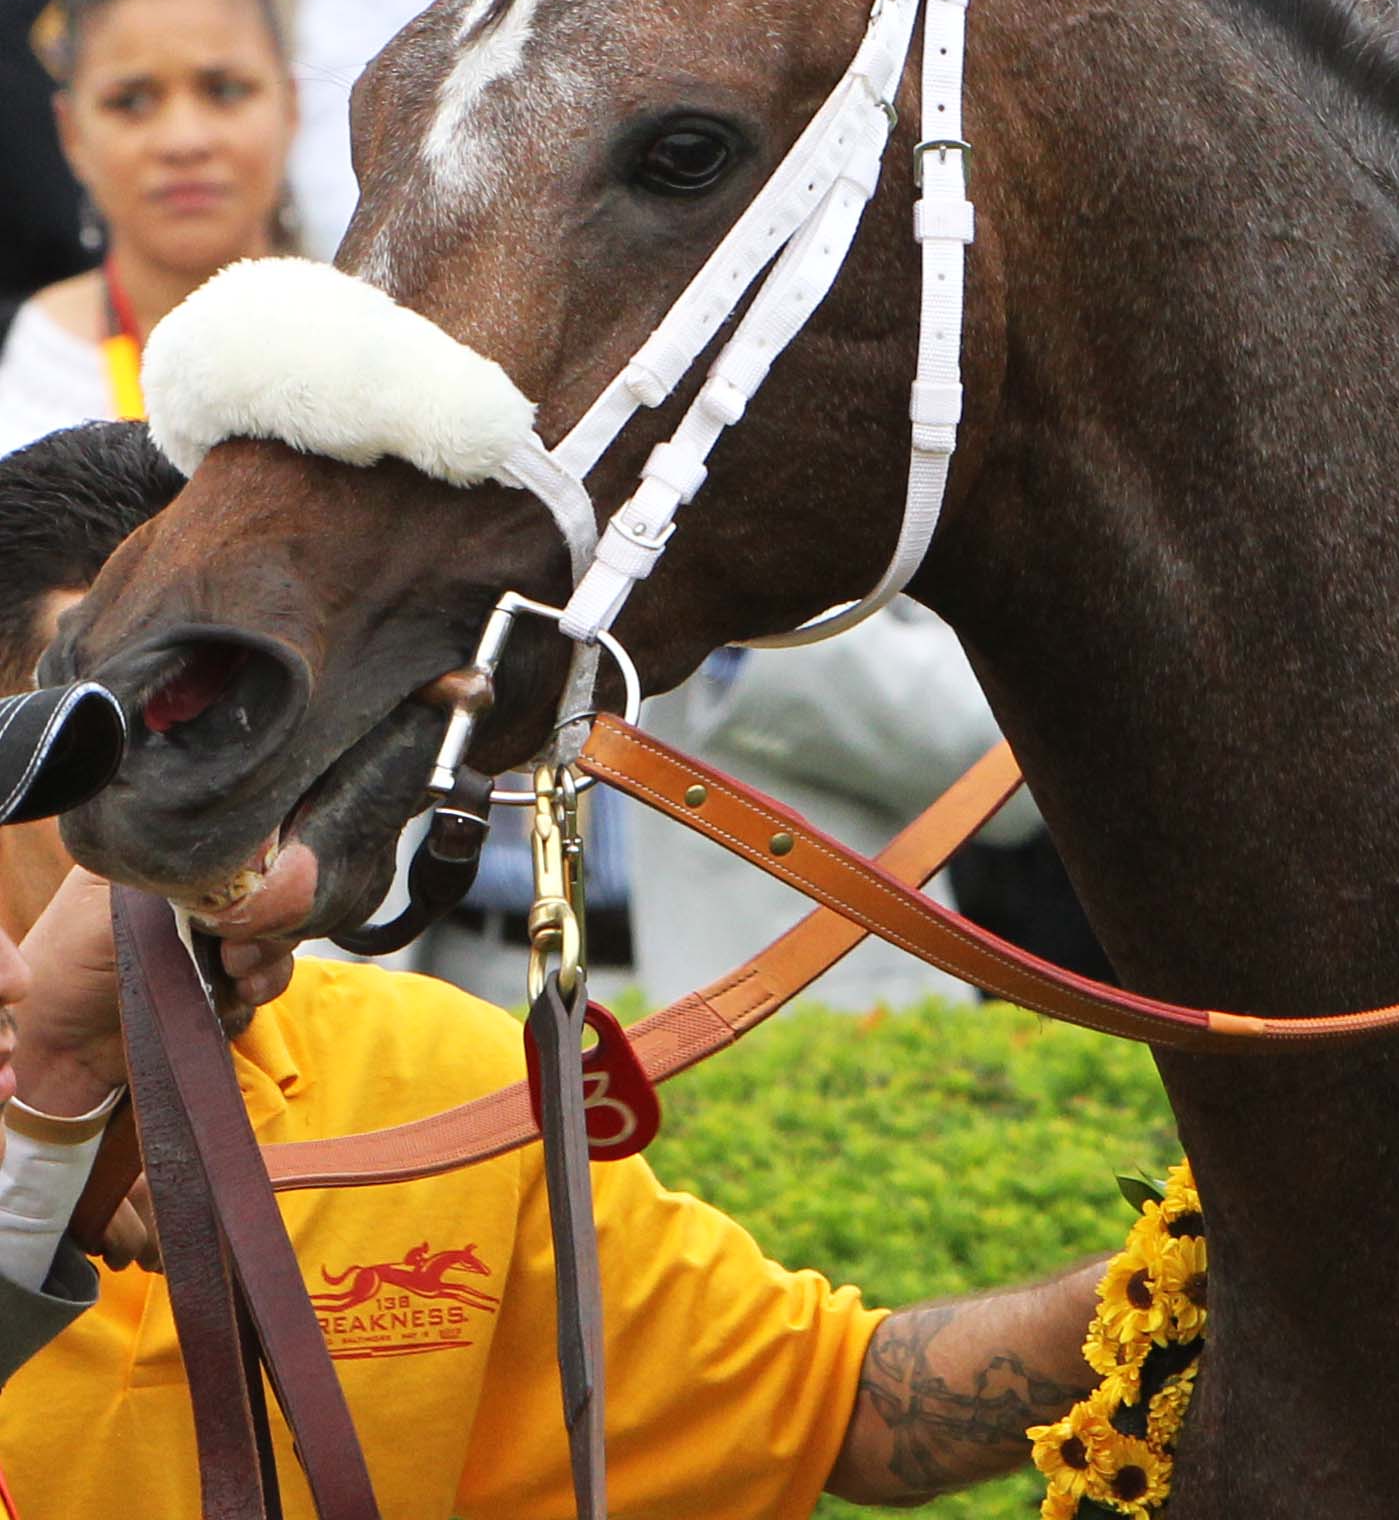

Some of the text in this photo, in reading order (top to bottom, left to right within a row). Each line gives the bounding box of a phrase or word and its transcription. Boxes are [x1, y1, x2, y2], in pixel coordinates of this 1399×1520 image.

[582, 1071, 638, 1147] 3
[376, 1296, 410, 1311] 138
[318, 1306, 465, 1335] REAKNESS
